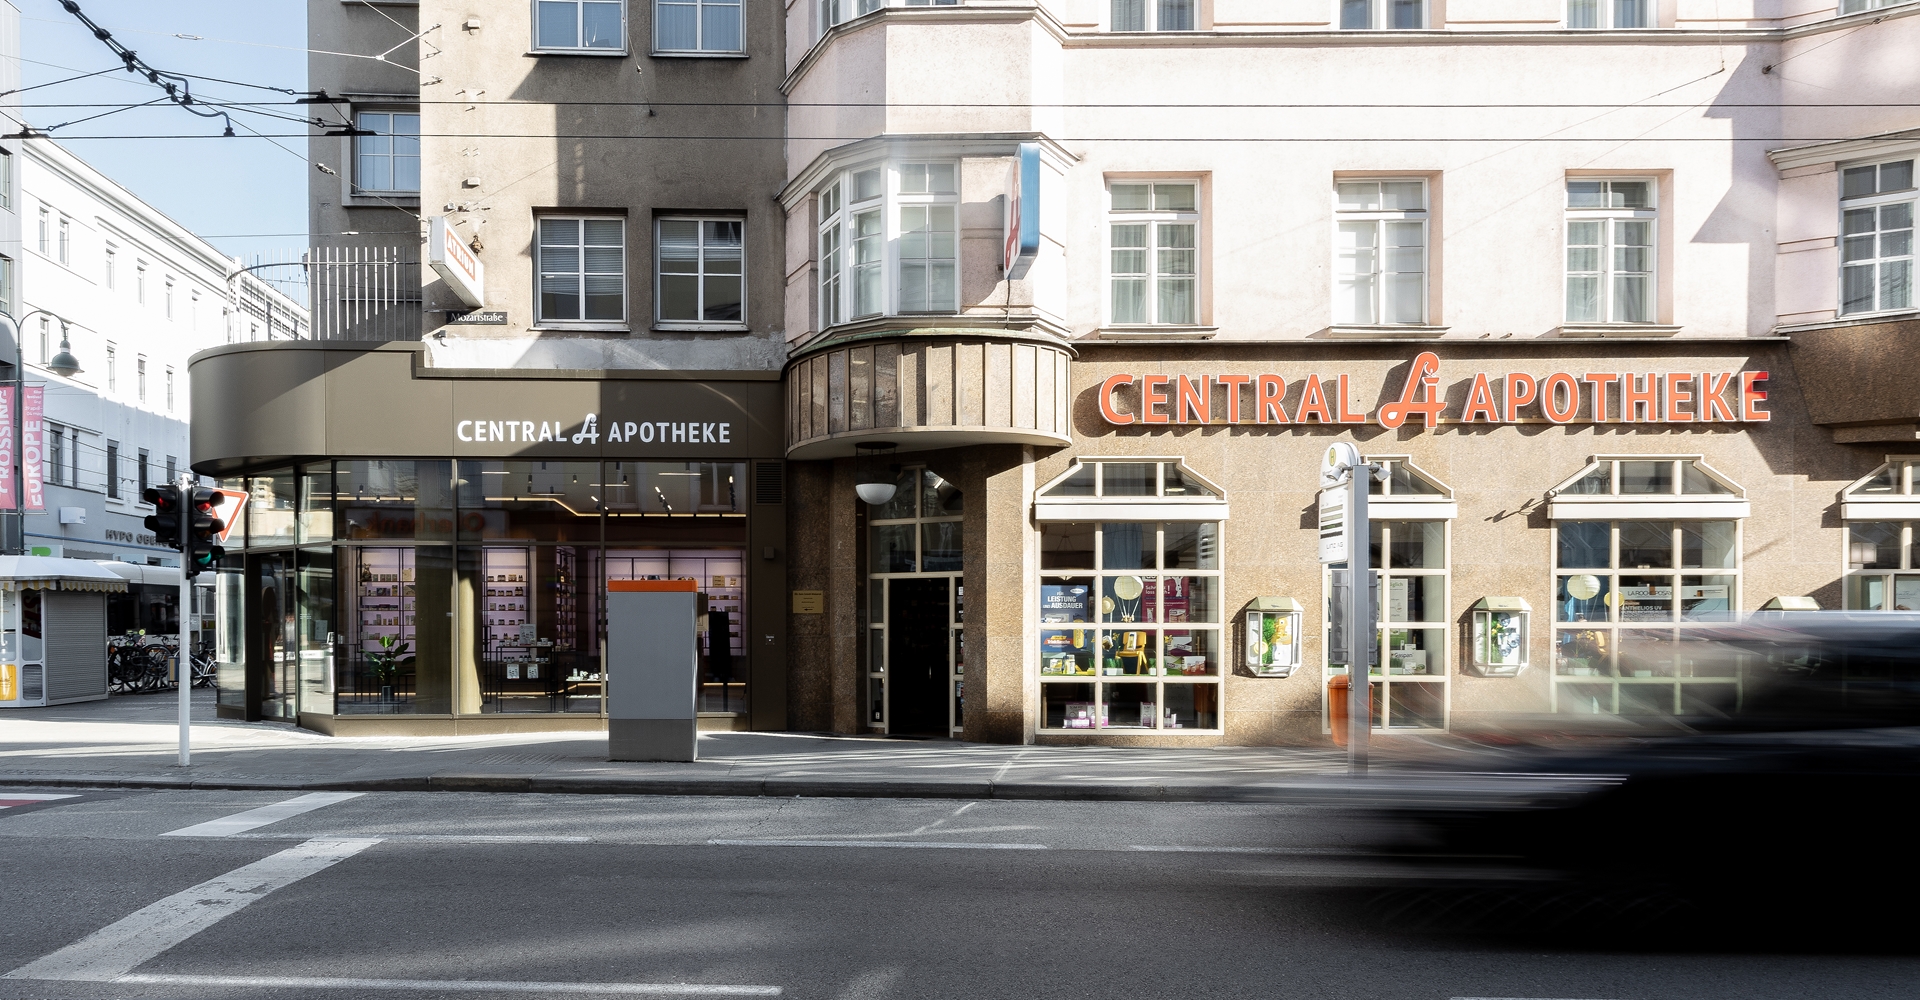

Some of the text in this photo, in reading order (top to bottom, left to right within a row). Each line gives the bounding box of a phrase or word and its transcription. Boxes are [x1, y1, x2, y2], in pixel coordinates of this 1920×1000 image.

[447, 233, 474, 278] ATRIUM
[1098, 373, 1366, 425] CENTRAL
[1460, 371, 1771, 424] APOTHEKE
[456, 420, 567, 442] CENTRAL
[608, 421, 731, 443] APOTHEKE
[24, 420, 43, 506] EUROPE
[105, 529, 133, 543] HYPO
